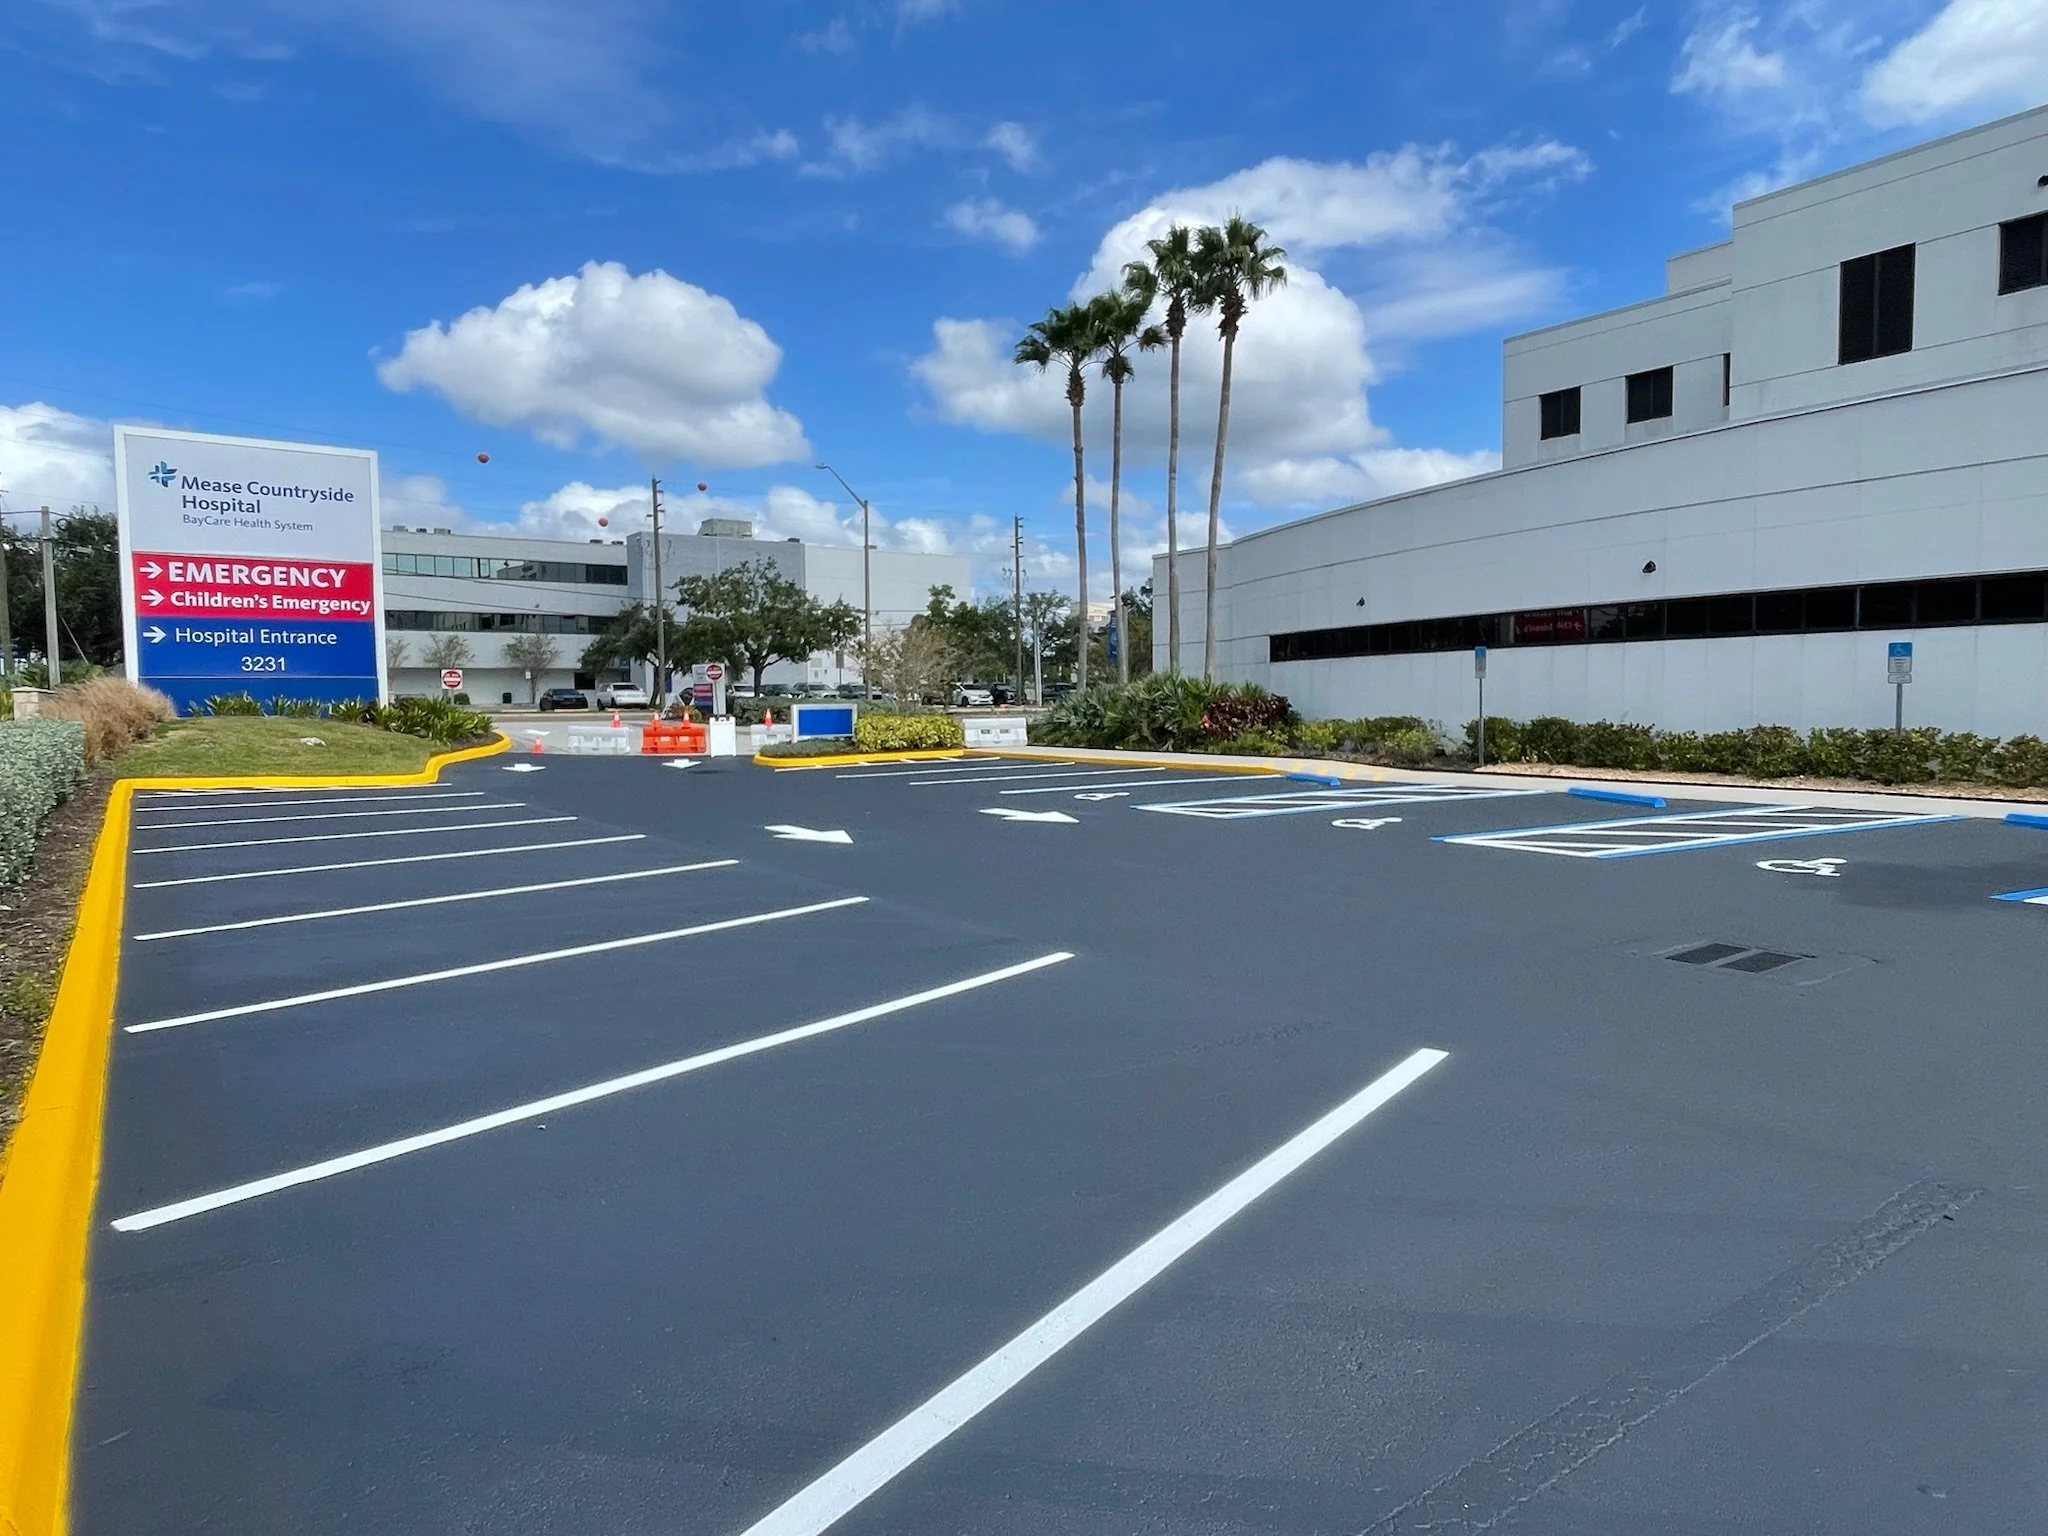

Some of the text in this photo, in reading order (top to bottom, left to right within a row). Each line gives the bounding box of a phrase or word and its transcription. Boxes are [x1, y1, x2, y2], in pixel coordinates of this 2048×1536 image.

[181, 476, 354, 503] Mease Countryside
[182, 495, 261, 515] Hospital
[182, 514, 313, 532] BayCare Health System
[168, 561, 346, 588] EMERGENCY
[170, 591, 371, 616] Children's Emergency
[175, 628, 337, 647] Hospital Entrance
[241, 656, 286, 672] 3231
